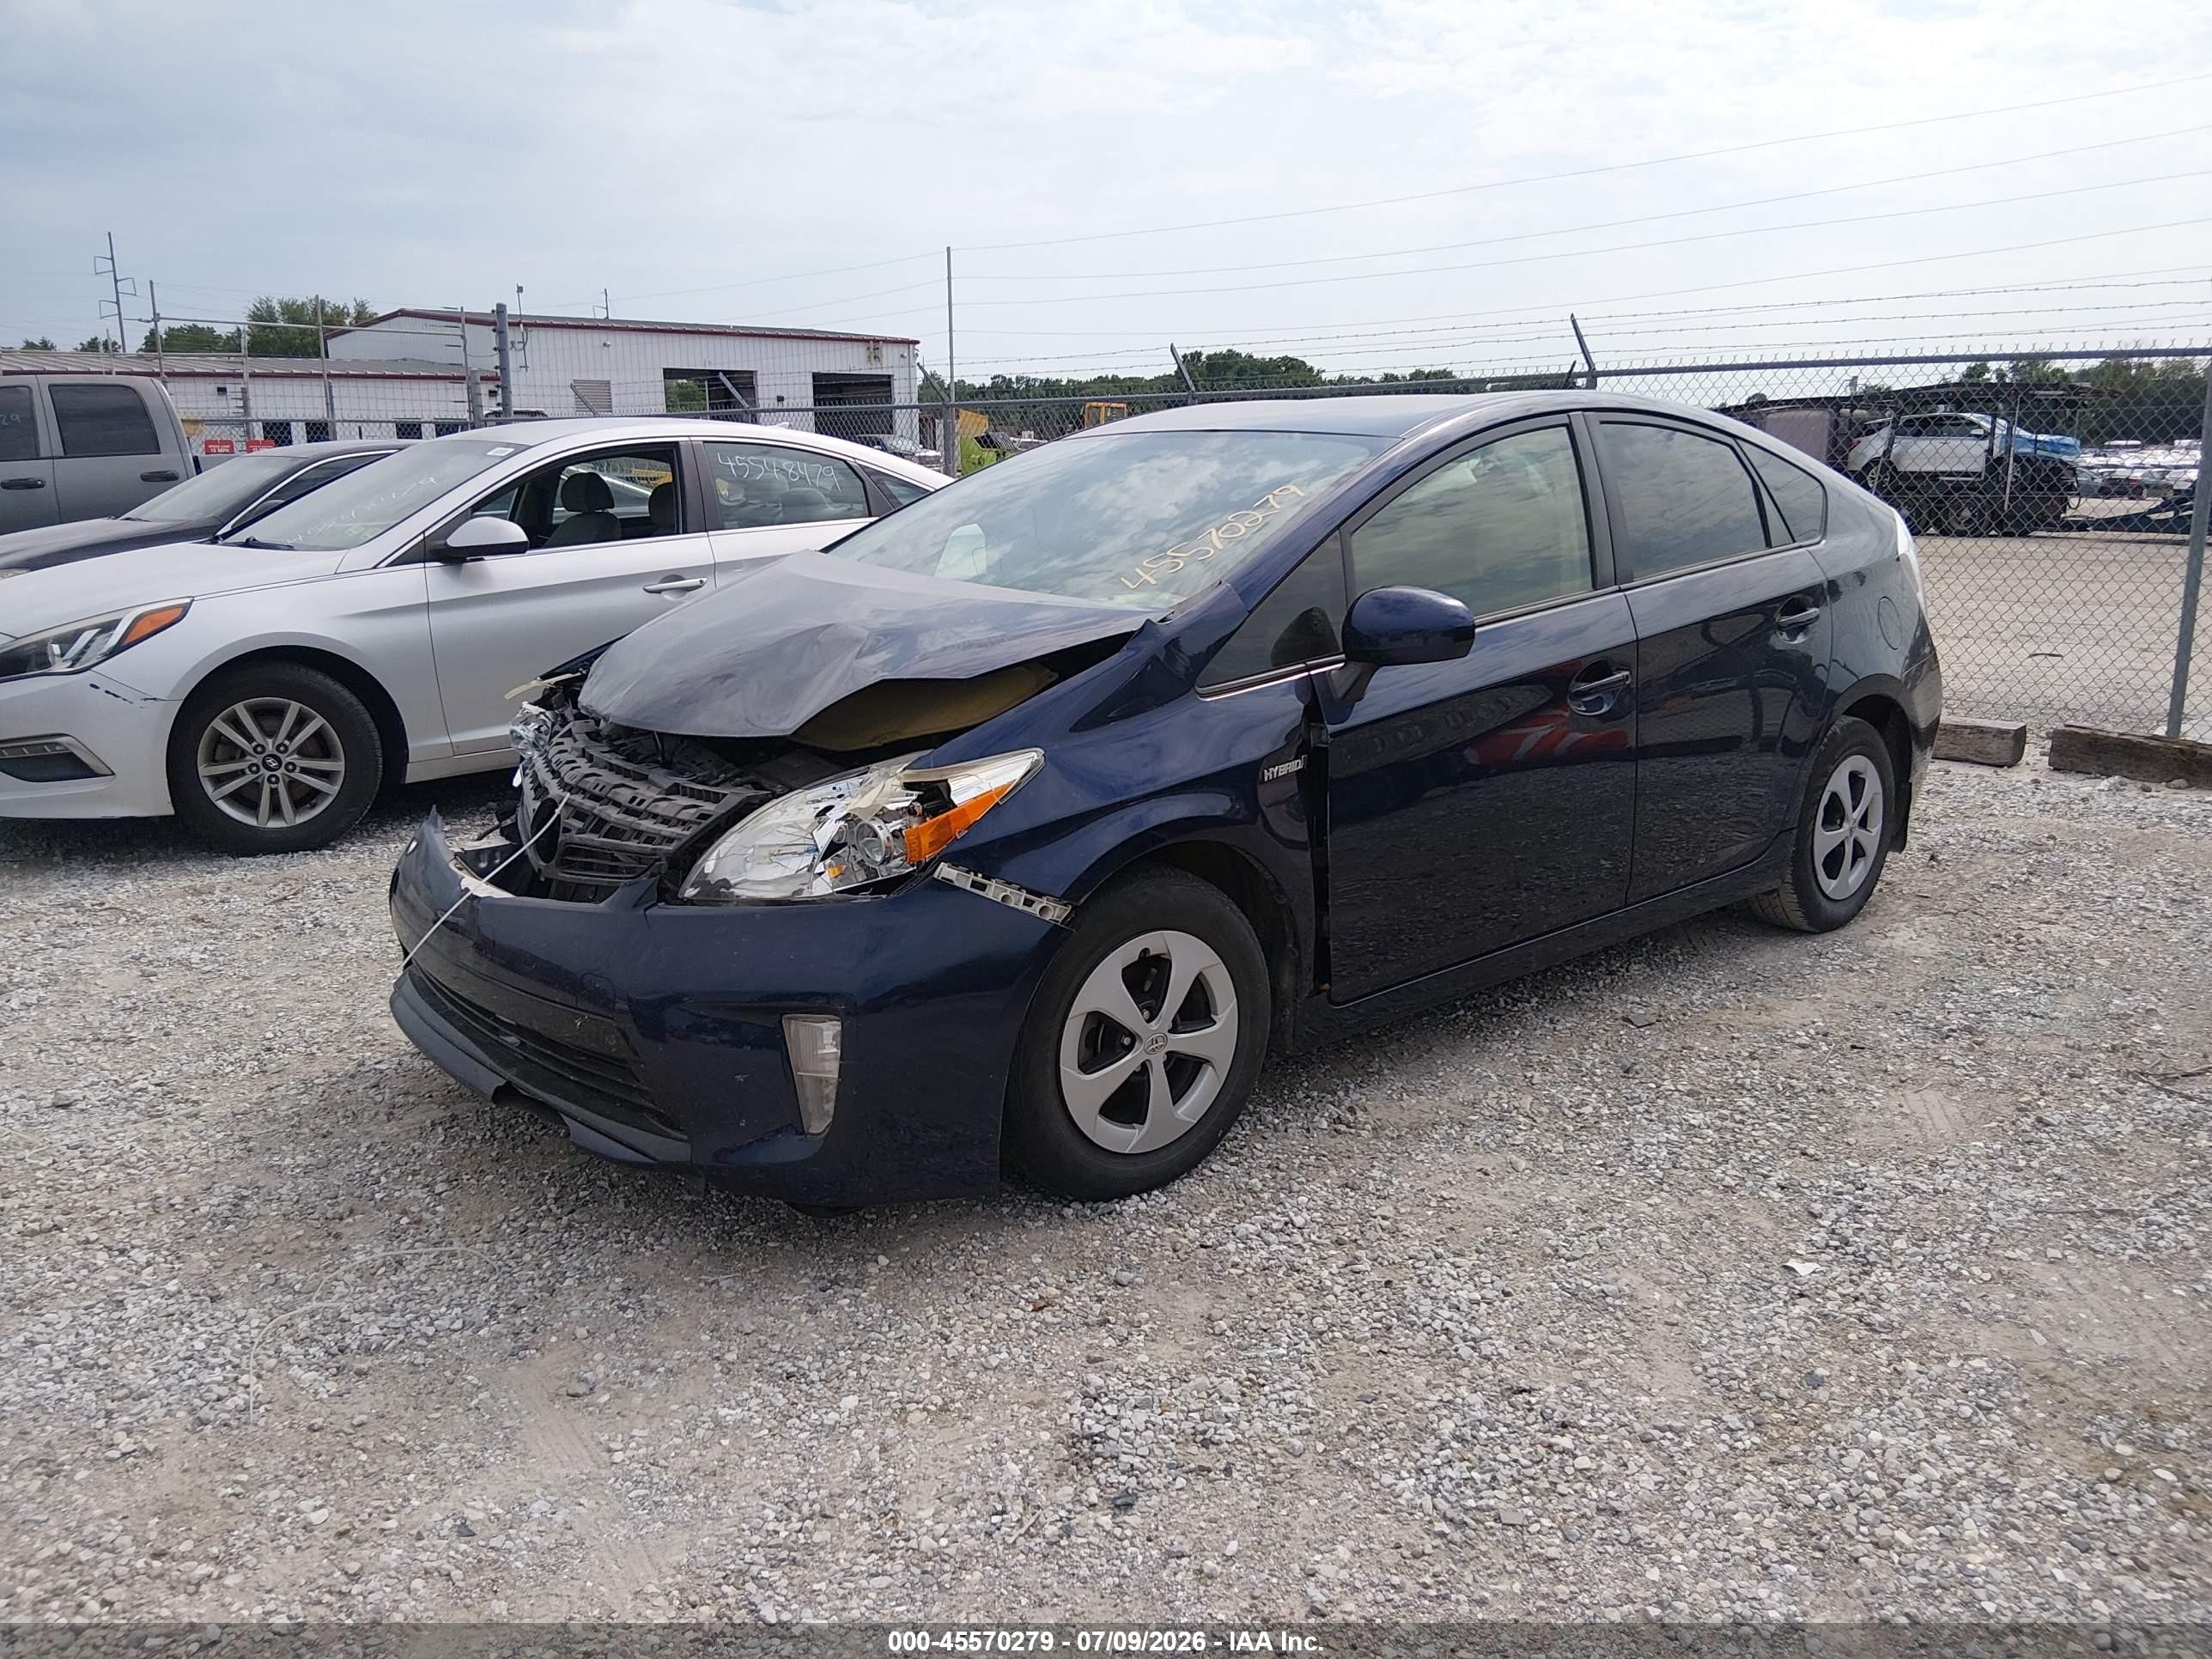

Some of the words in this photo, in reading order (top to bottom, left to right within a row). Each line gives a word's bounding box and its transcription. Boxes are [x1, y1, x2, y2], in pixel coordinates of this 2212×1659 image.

[717, 453, 842, 493] 45548479
[1120, 484, 1306, 590] 45570279
[1263, 758, 1304, 782] HYBRID
